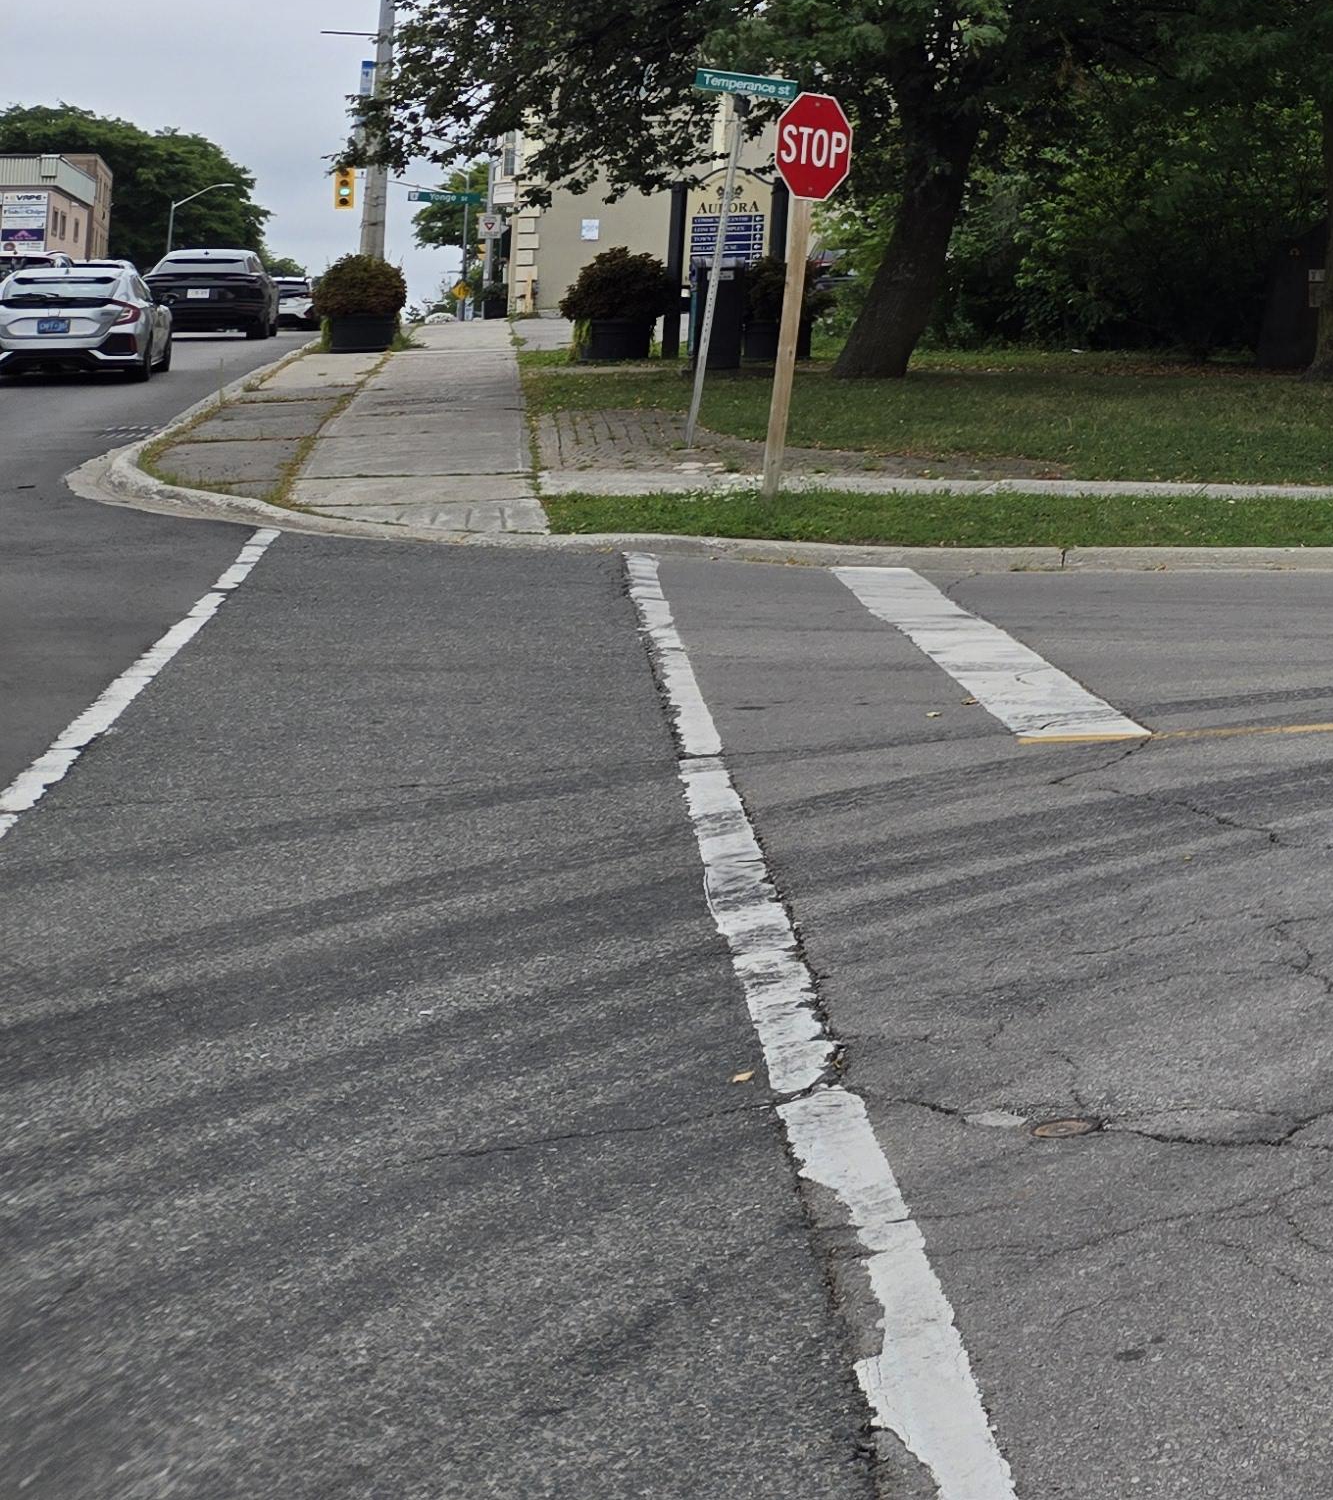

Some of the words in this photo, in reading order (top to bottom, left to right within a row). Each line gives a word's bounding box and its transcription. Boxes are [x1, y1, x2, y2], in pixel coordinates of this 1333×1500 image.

[703, 73, 775, 94] Temperance
[777, 83, 792, 96] st
[780, 124, 848, 169] STOP
[429, 192, 457, 203] Yonge
